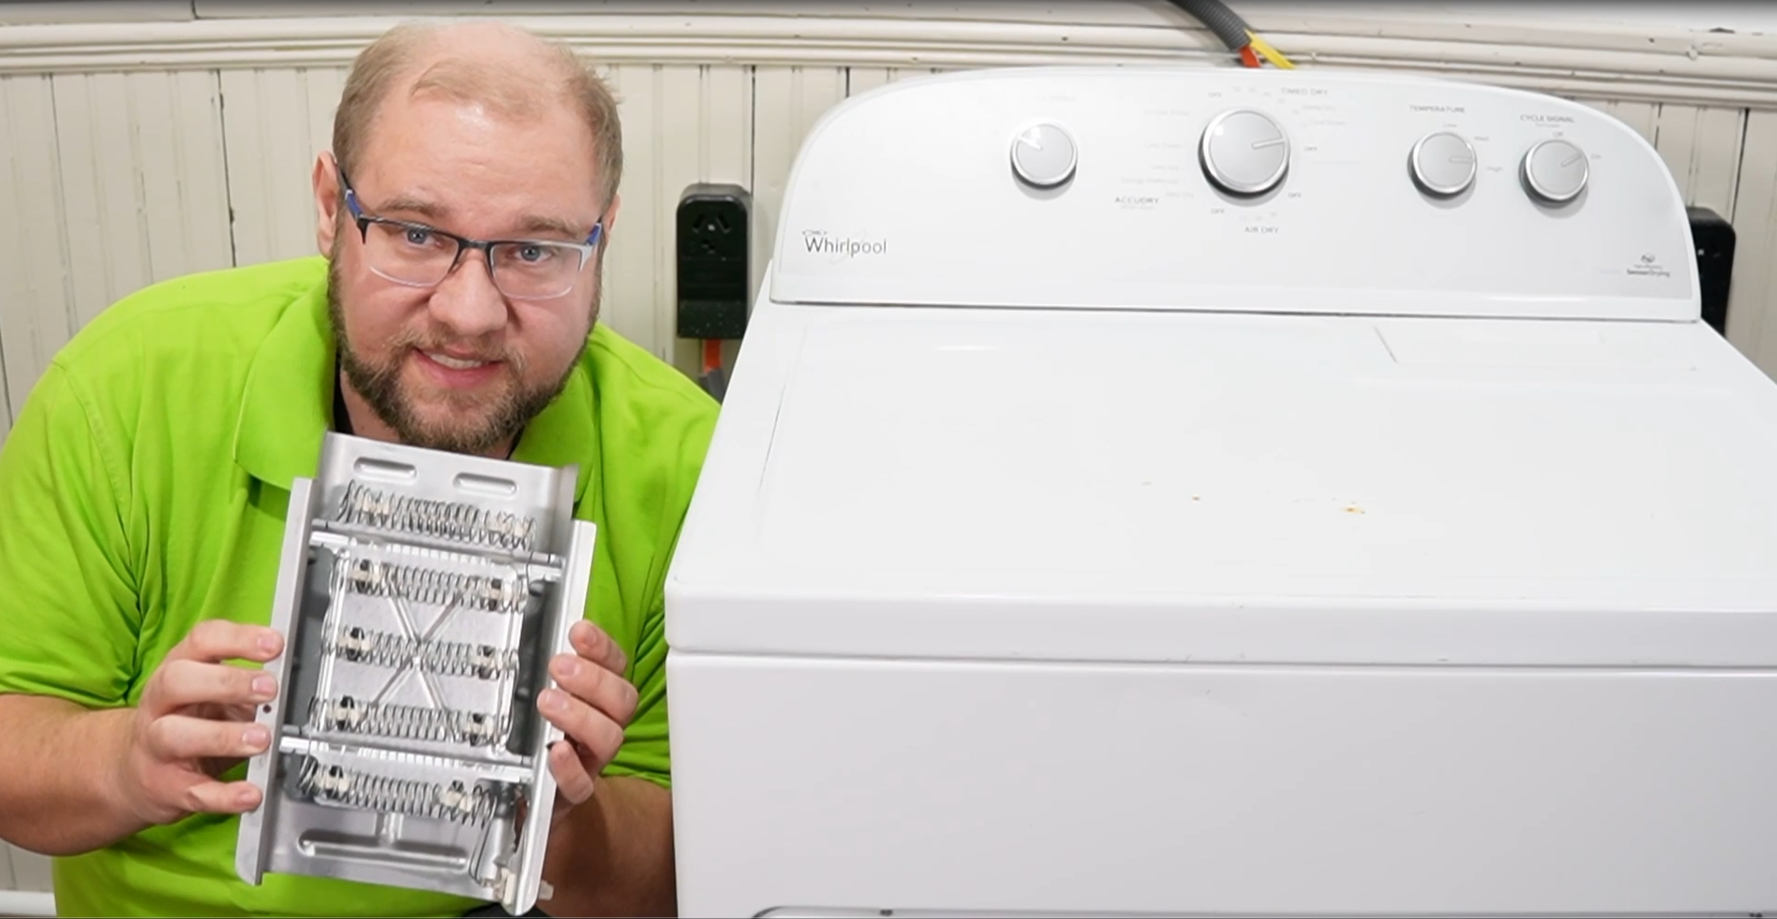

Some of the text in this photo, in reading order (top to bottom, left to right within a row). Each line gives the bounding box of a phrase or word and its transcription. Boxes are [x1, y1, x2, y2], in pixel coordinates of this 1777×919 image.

[1310, 88, 1328, 96] DRY
[1409, 105, 1465, 113] TEMPERATURE
[1519, 114, 1575, 123] CYCLE SIGNAL
[804, 236, 887, 258] Whirlpool
